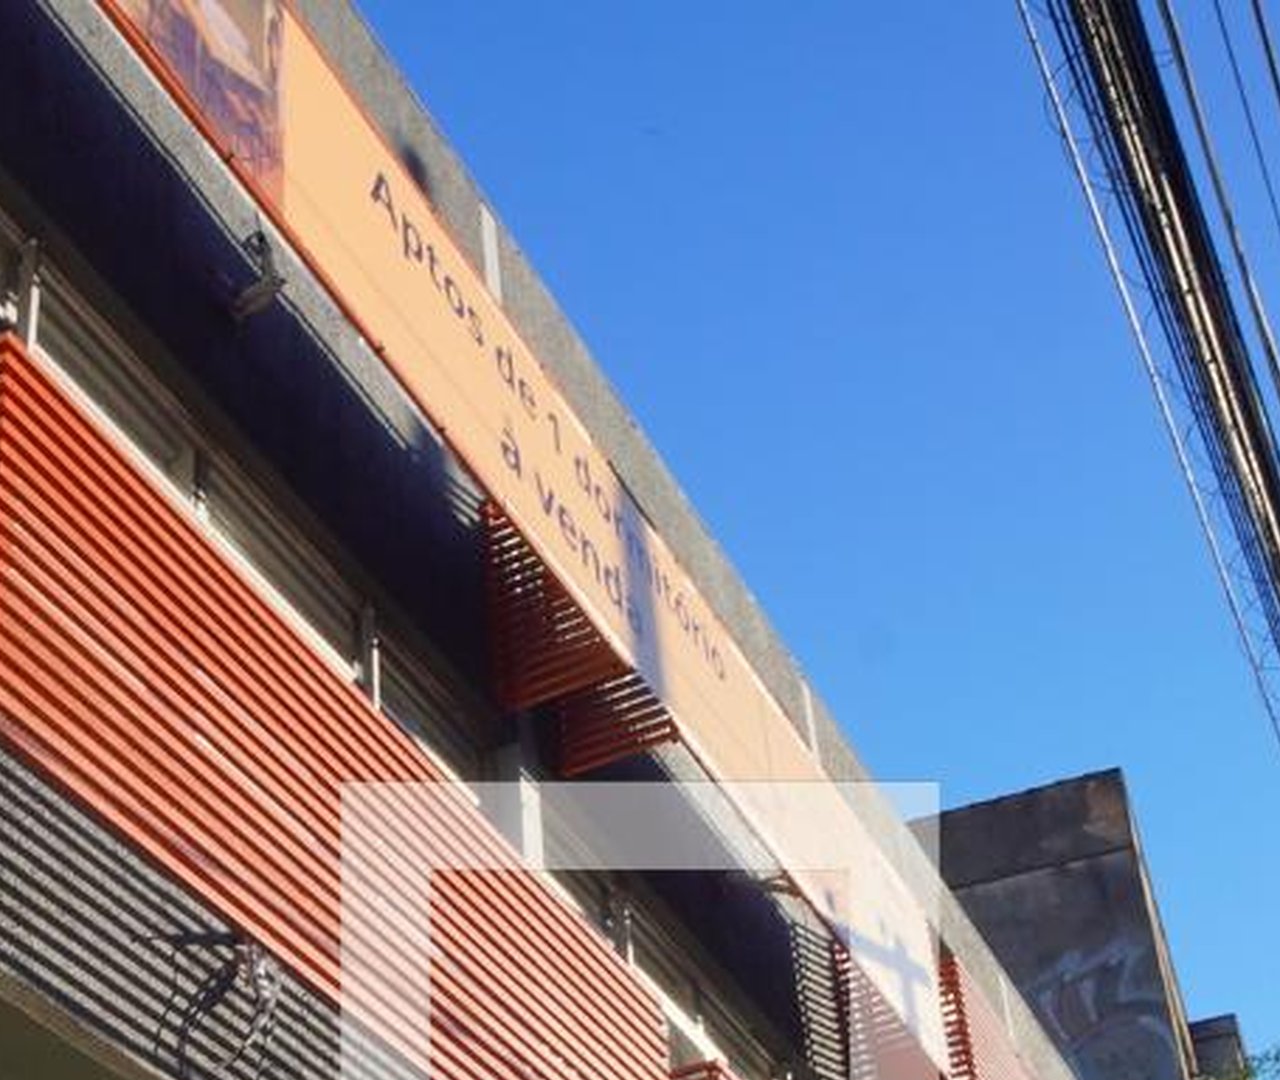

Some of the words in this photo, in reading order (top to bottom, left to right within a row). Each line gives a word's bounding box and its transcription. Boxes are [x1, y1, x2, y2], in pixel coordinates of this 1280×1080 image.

[370, 171, 485, 347] Aptos
[496, 346, 538, 420] de
[548, 411, 561, 453] 1
[534, 471, 643, 635] venda
